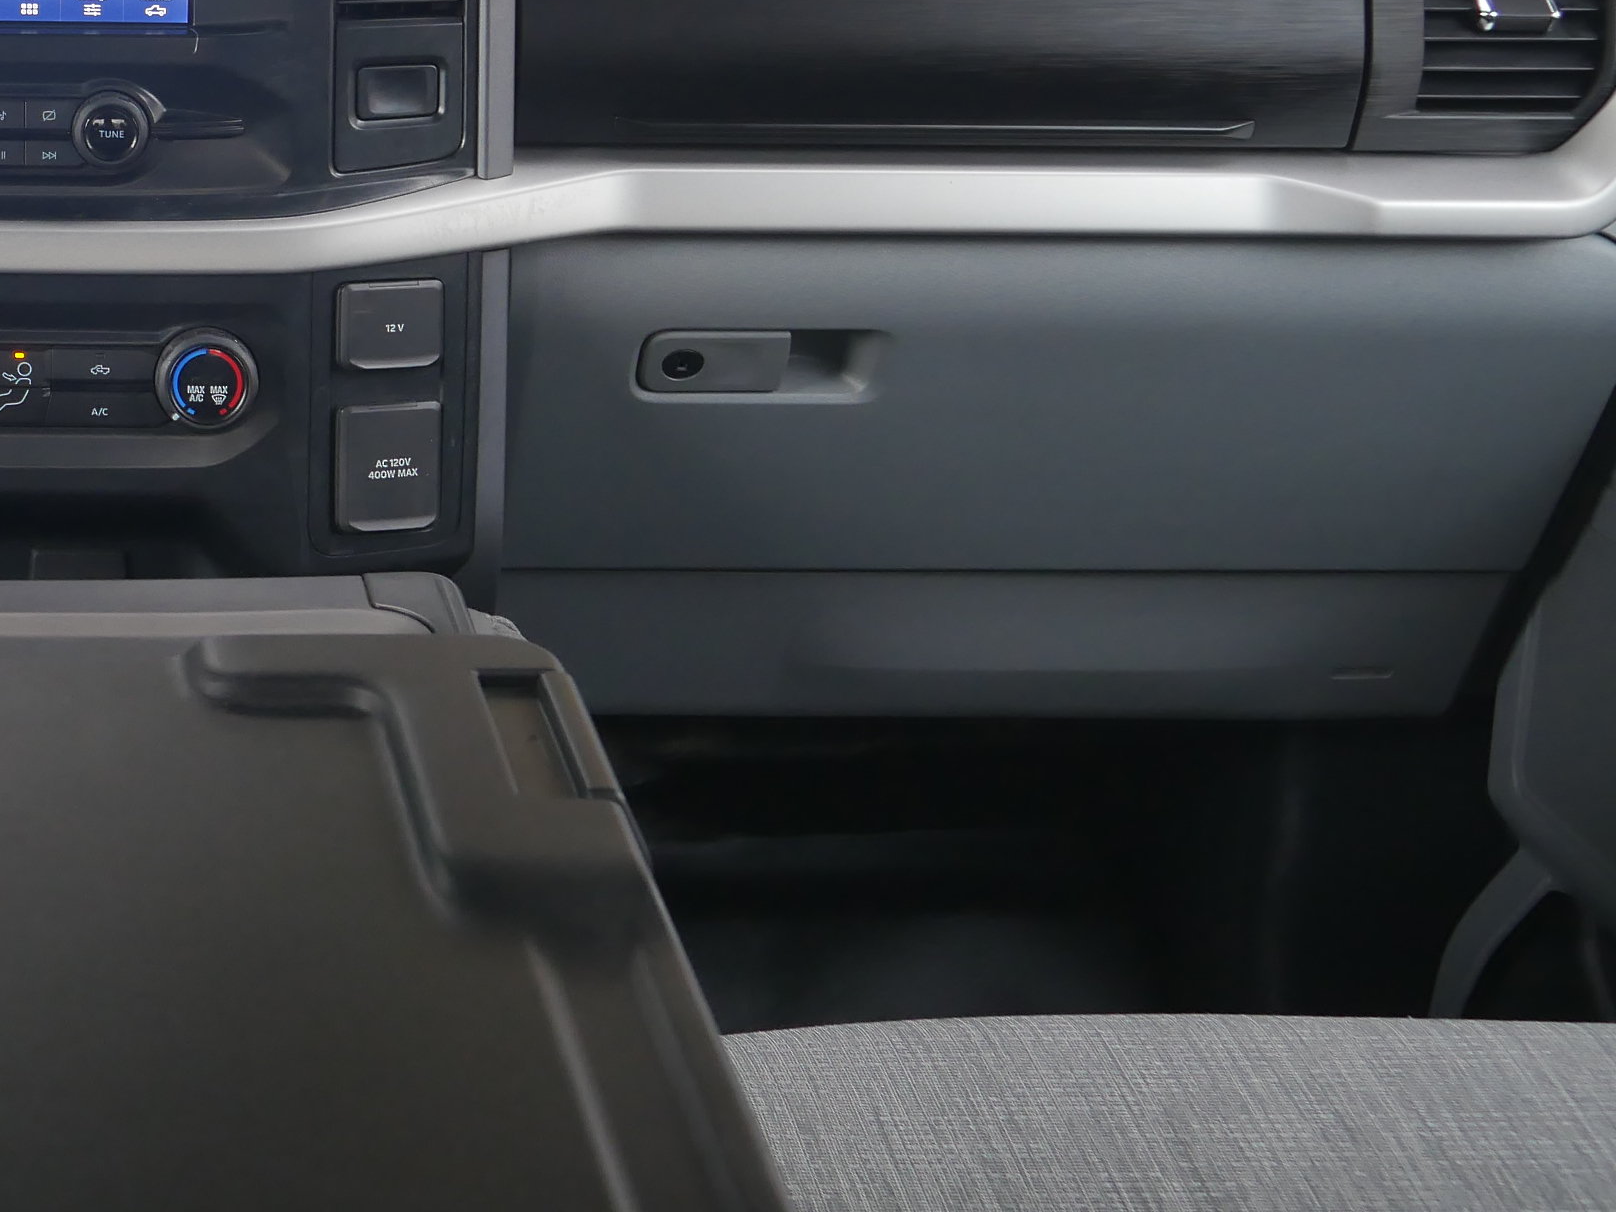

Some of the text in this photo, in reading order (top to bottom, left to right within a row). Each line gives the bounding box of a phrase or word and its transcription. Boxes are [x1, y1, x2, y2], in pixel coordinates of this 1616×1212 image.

[99, 130, 125, 139] TUNE
[385, 323, 405, 333] 12 V
[187, 385, 205, 394] MAX
[210, 385, 228, 394] MAX
[189, 394, 204, 402] A/C
[91, 406, 109, 417] A/C
[375, 457, 412, 468] AC 120V
[368, 468, 418, 480] 400W MAX
